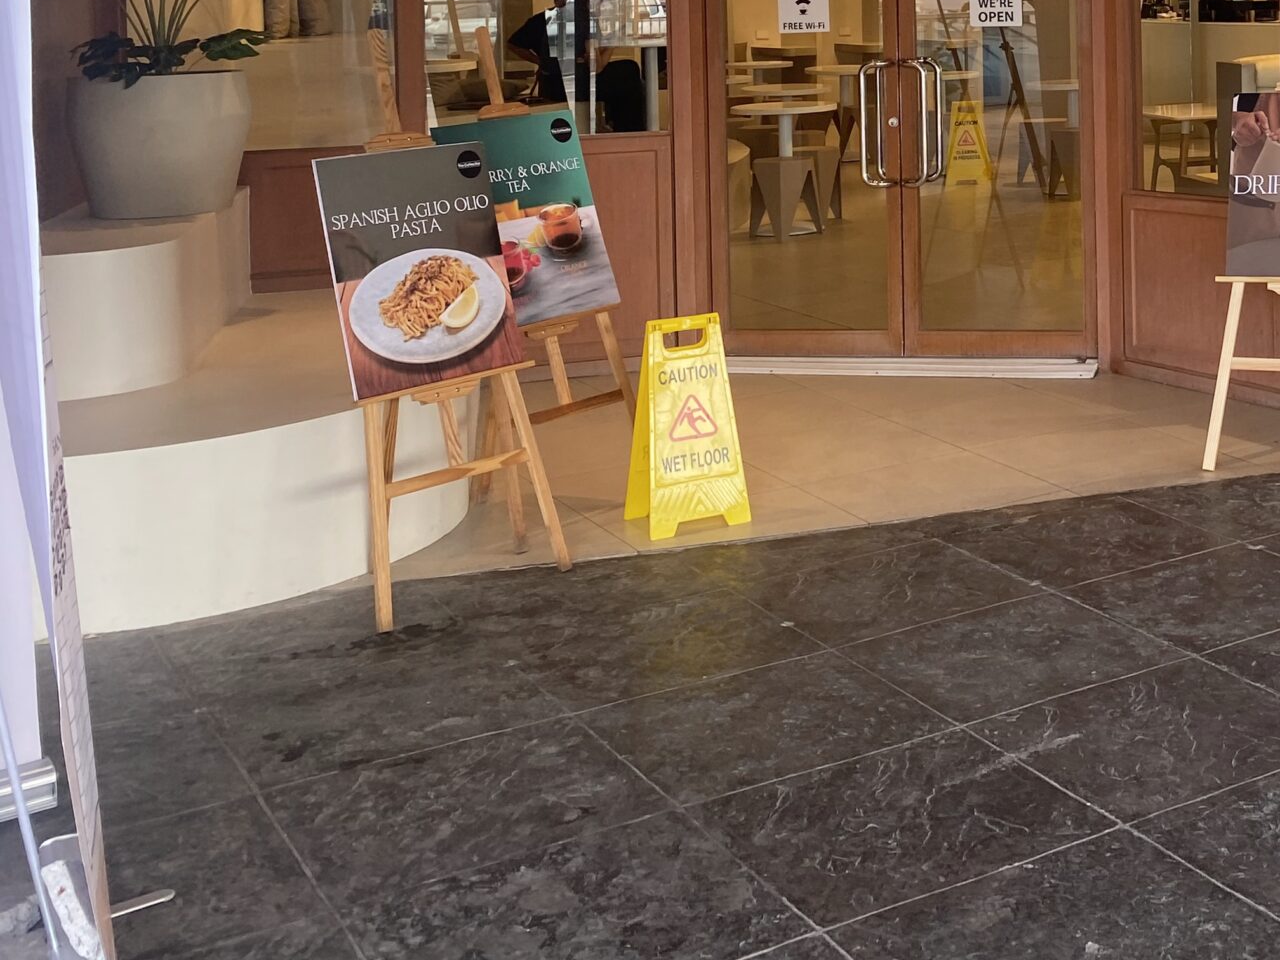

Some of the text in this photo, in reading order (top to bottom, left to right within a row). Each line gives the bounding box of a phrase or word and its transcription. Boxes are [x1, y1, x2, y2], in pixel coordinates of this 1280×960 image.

[783, 21, 825, 30] FREE Wi-Fi
[978, 11, 1014, 23] OPEN
[517, 165, 528, 178] &
[530, 157, 580, 176] ORANGE
[505, 178, 531, 194] TEA
[331, 194, 489, 231] SPANISH AGLIO OLIO
[390, 218, 442, 239] PASTA
[657, 362, 718, 386] CAUTION
[661, 446, 730, 475] WET FLOOR
